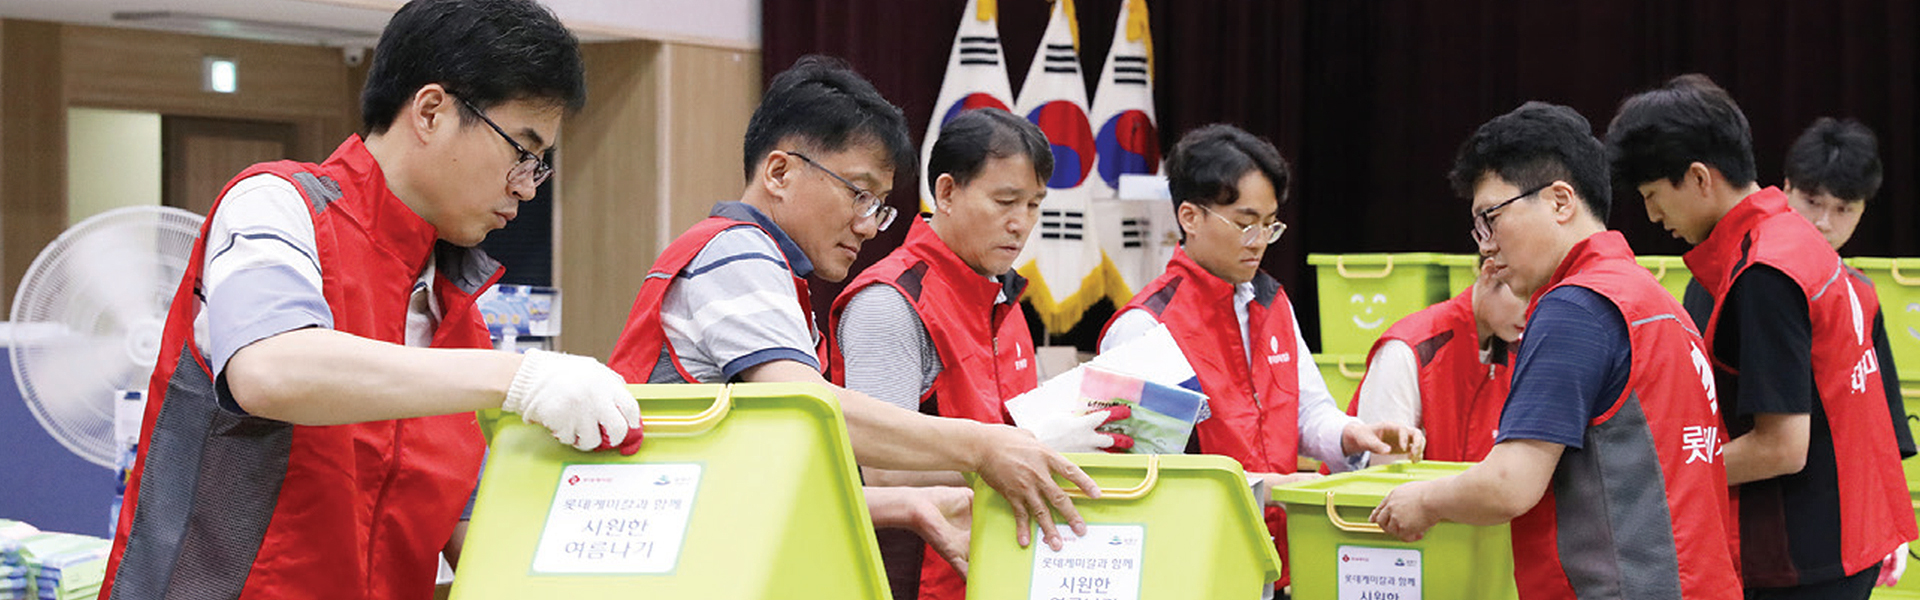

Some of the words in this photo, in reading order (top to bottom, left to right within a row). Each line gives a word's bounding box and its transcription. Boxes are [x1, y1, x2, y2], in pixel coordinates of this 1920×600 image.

[564, 499, 649, 511] 롯데케미칼과
[654, 499, 682, 511] 함께
[583, 518, 649, 537] 시원한
[564, 540, 654, 559] 여름나기
[1041, 557, 1108, 570] 롯데케미칼과
[1111, 557, 1133, 570] 함께
[1061, 576, 1111, 594] 시원한
[1345, 574, 1396, 586] 롯데케미칼과
[1398, 576, 1416, 587] 함께
